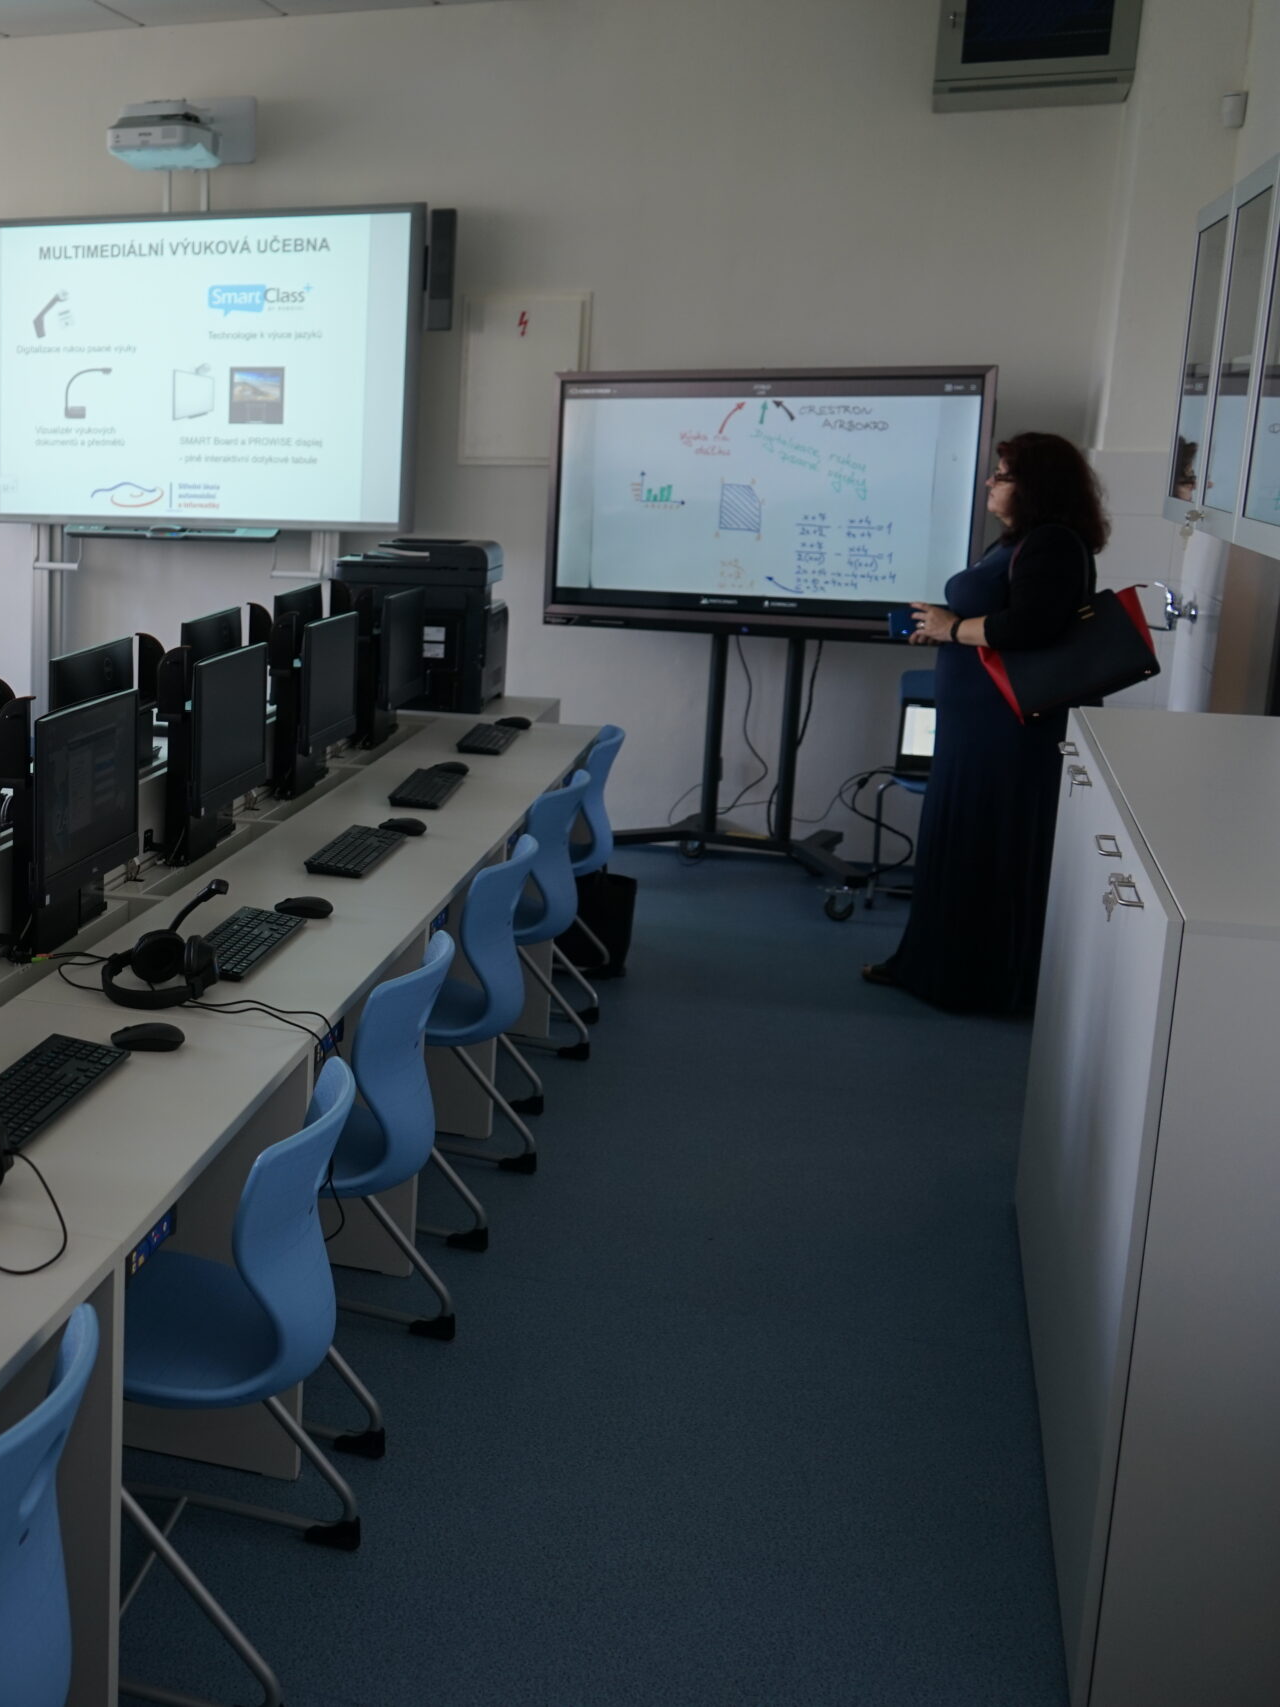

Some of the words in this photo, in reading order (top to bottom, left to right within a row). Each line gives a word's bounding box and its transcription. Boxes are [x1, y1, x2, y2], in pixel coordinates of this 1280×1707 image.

[38, 239, 165, 261] MULTIMEDIÁLNÍ
[169, 236, 252, 256] VÝUKOVÁ
[256, 234, 331, 254] UČEBNA
[209, 331, 257, 341] Technologie
[268, 331, 292, 340] výuce
[294, 330, 322, 341] jazyků
[16, 345, 61, 355] Digitalizace
[114, 344, 137, 354] výuky
[180, 436, 211, 446] SMART
